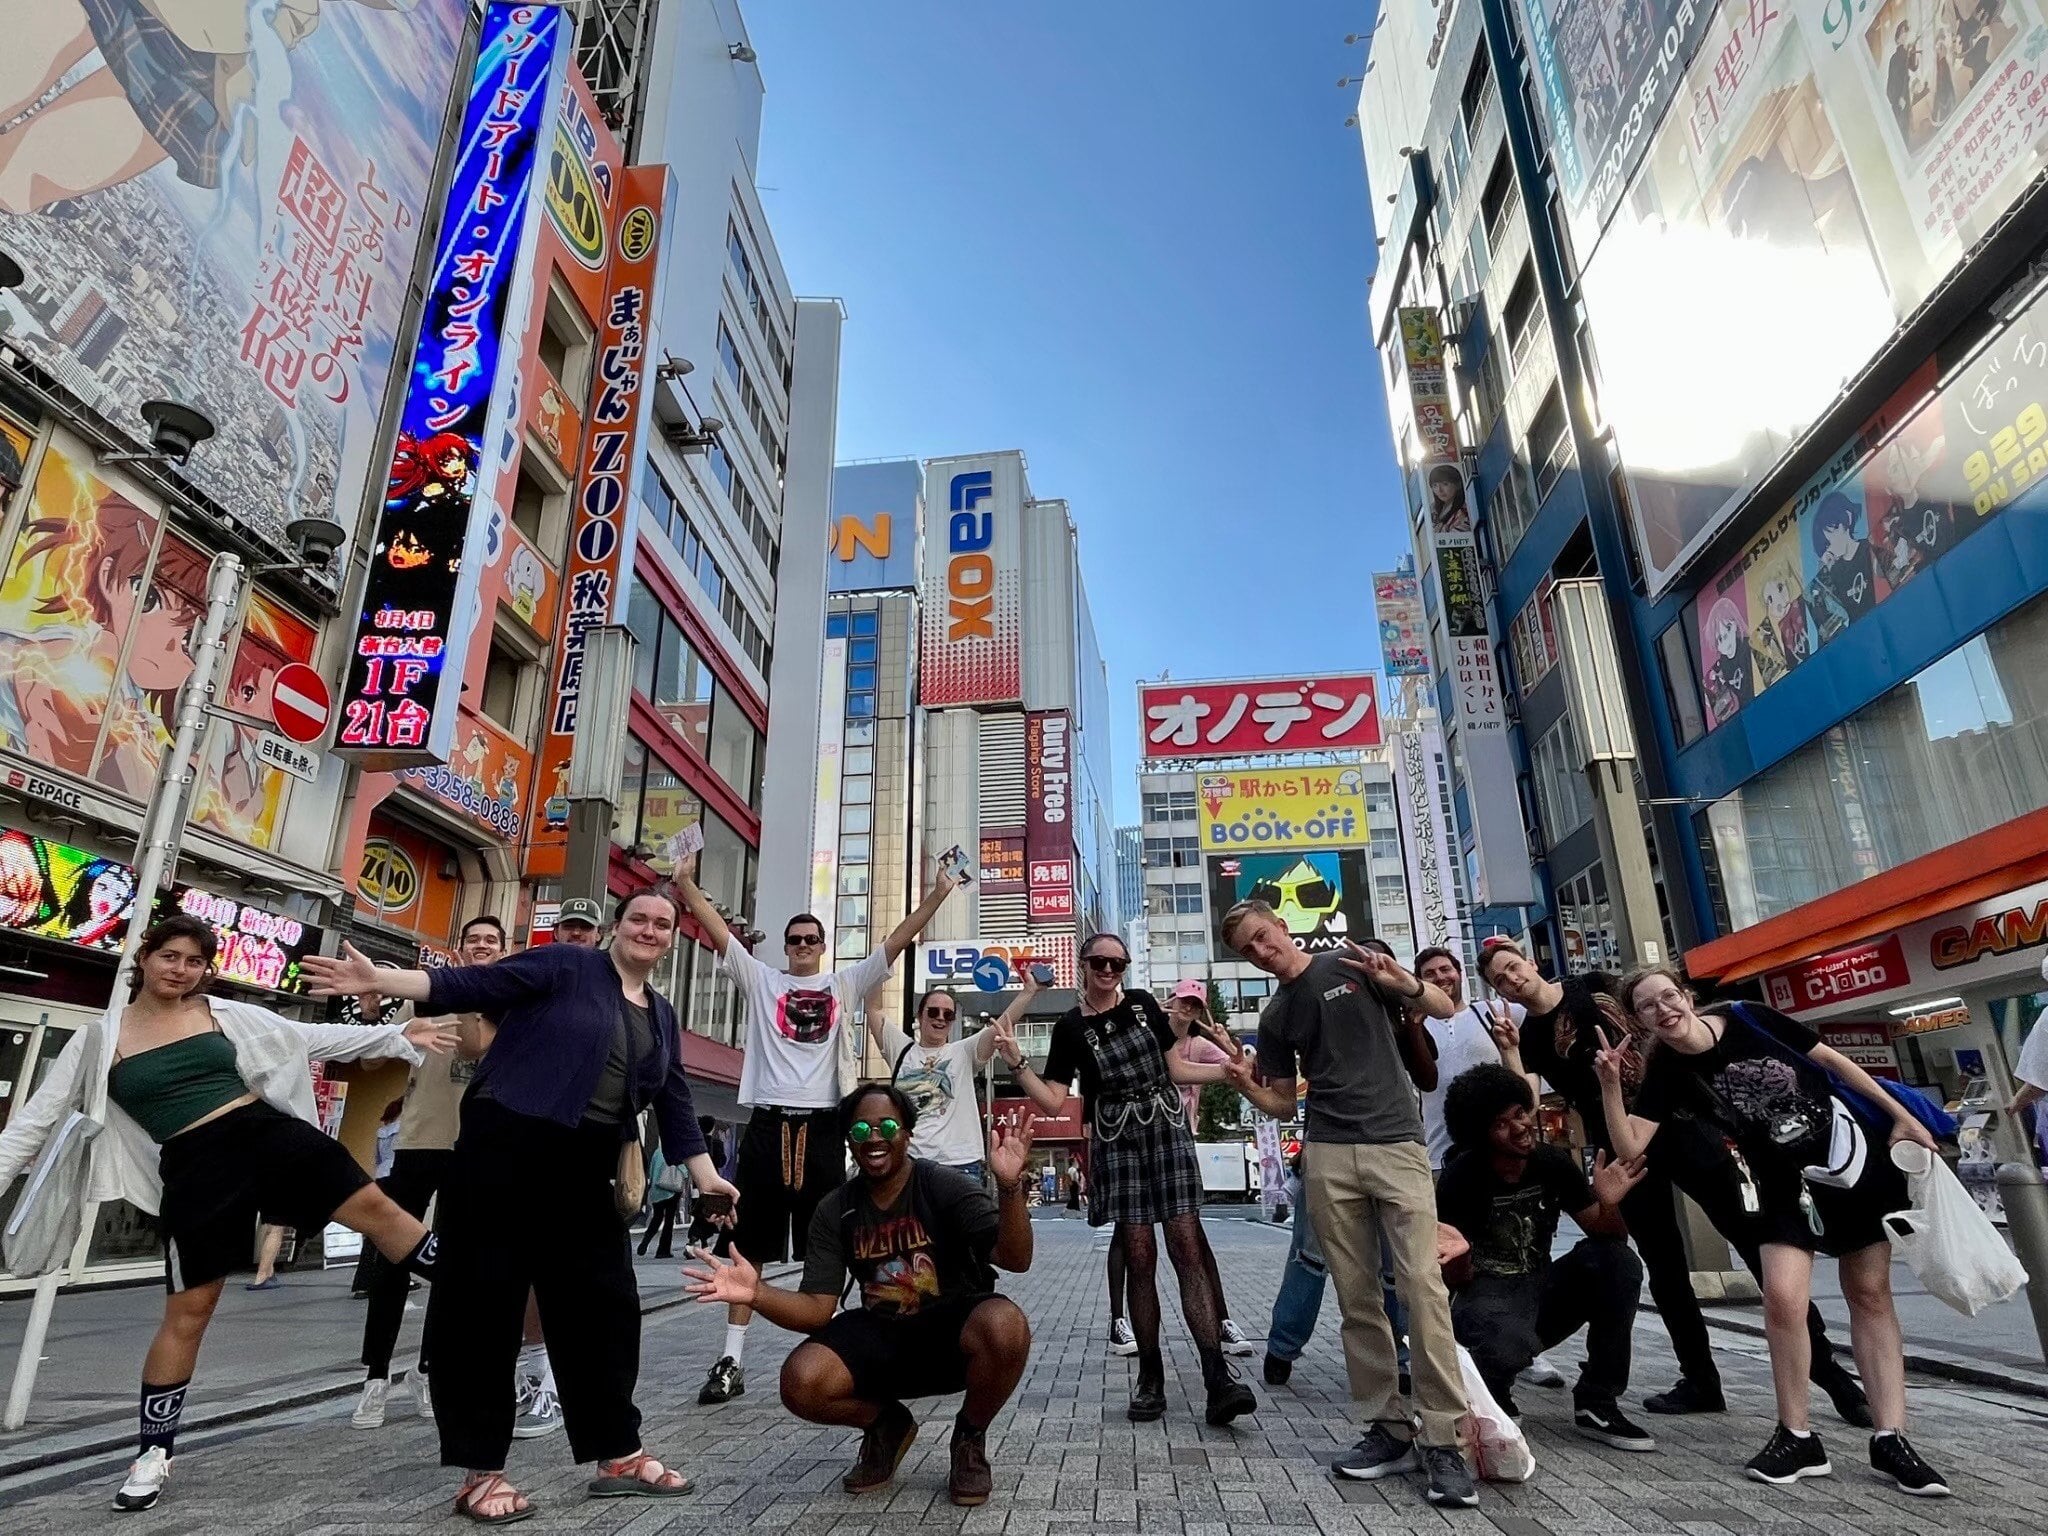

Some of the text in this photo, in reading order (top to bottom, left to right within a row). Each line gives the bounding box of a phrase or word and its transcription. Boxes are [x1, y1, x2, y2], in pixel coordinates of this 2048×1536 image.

[561, 78, 613, 207] IBA
[1963, 403, 2047, 491] 9.29
[1974, 477, 2008, 516] ON
[830, 513, 891, 562] N
[341, 698, 431, 745] 21台
[1148, 681, 1371, 746] オノデン
[262, 739, 313, 776] 自転車を除く
[1030, 718, 1041, 799] Flagship Store
[1041, 717, 1068, 823] Duty Free
[27, 778, 82, 809] ESPACE
[1240, 776, 1333, 799] 駅から1分
[360, 854, 410, 896] ZOO
[1033, 865, 1068, 882] 免税
